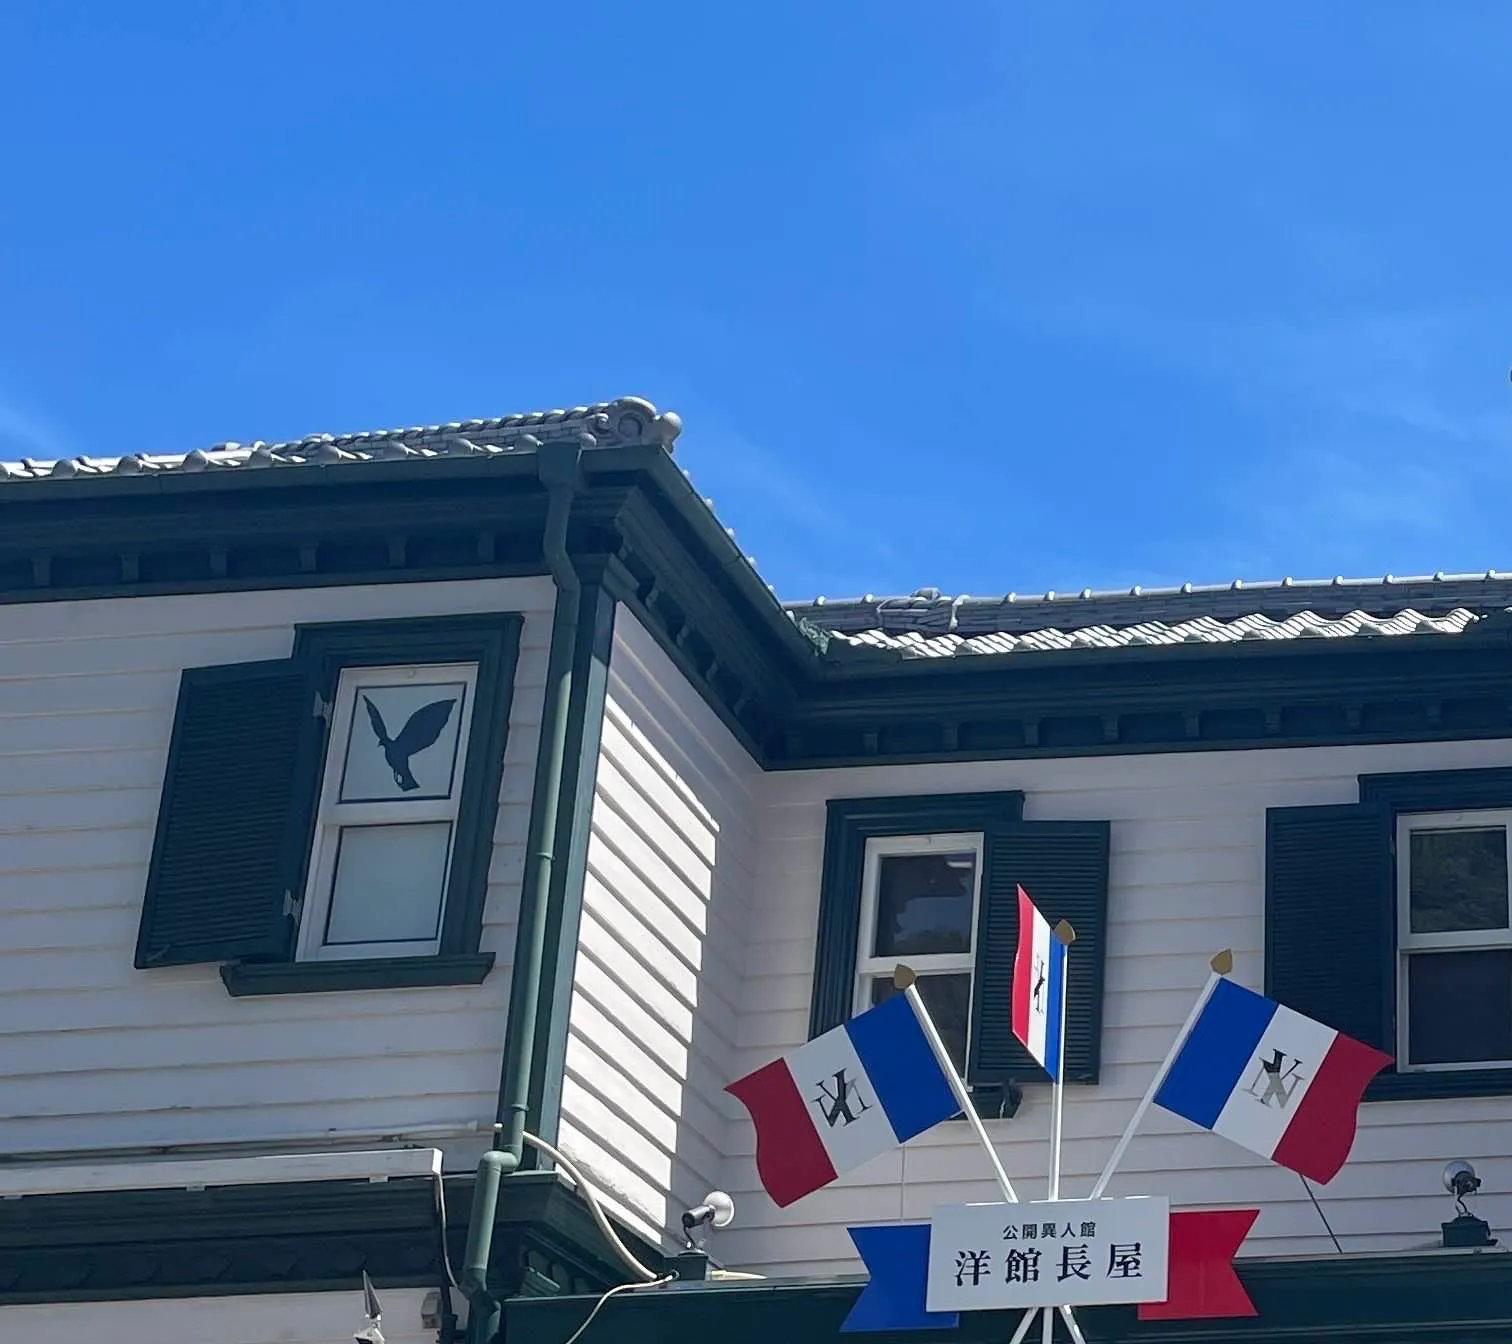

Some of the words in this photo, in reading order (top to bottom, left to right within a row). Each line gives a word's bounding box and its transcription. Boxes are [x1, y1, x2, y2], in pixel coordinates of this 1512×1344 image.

[1003, 1221, 1097, 1240] 公開異人館
[955, 1242, 1143, 1287] 洋館長屋
